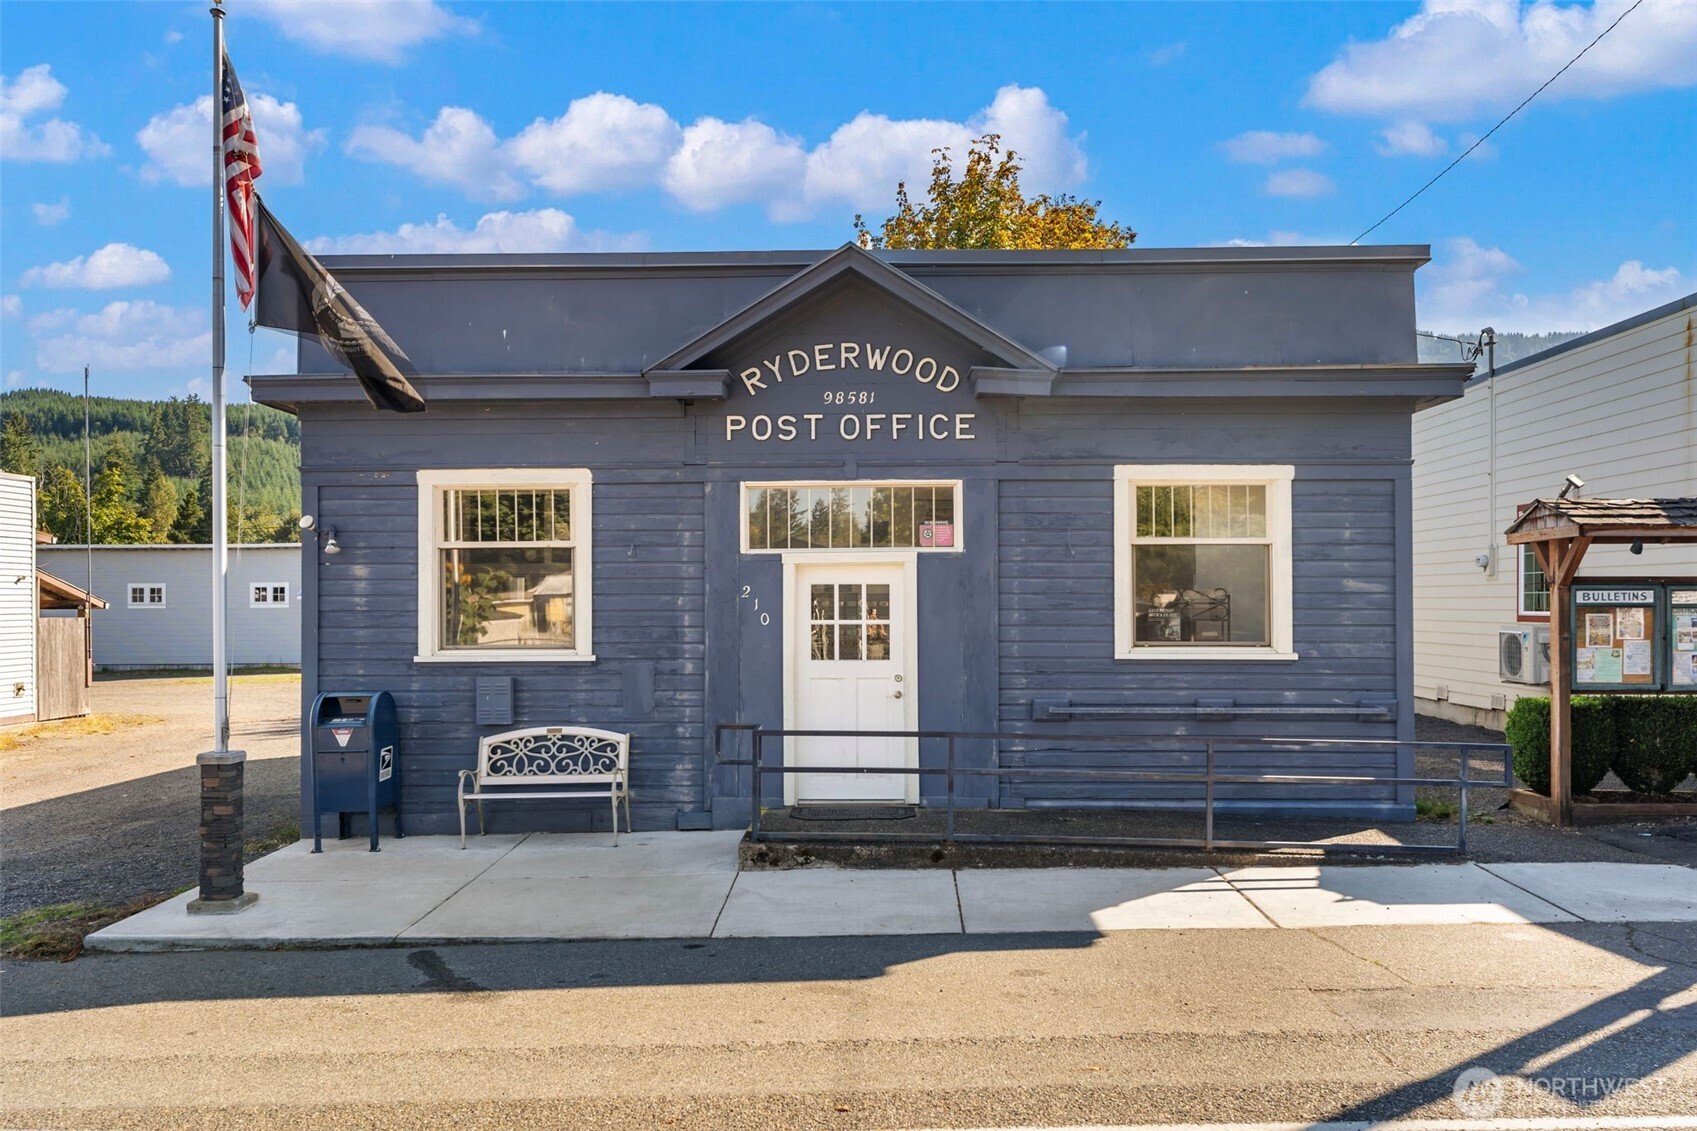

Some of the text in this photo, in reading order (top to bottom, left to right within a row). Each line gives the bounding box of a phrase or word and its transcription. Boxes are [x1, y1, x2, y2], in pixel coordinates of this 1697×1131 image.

[740, 342, 960, 396] RYDERWOOD
[823, 391, 875, 405] 98581
[726, 413, 976, 441] POST OFFICE
[741, 585, 770, 626] 210
[1582, 591, 1648, 602] BULLETINS
